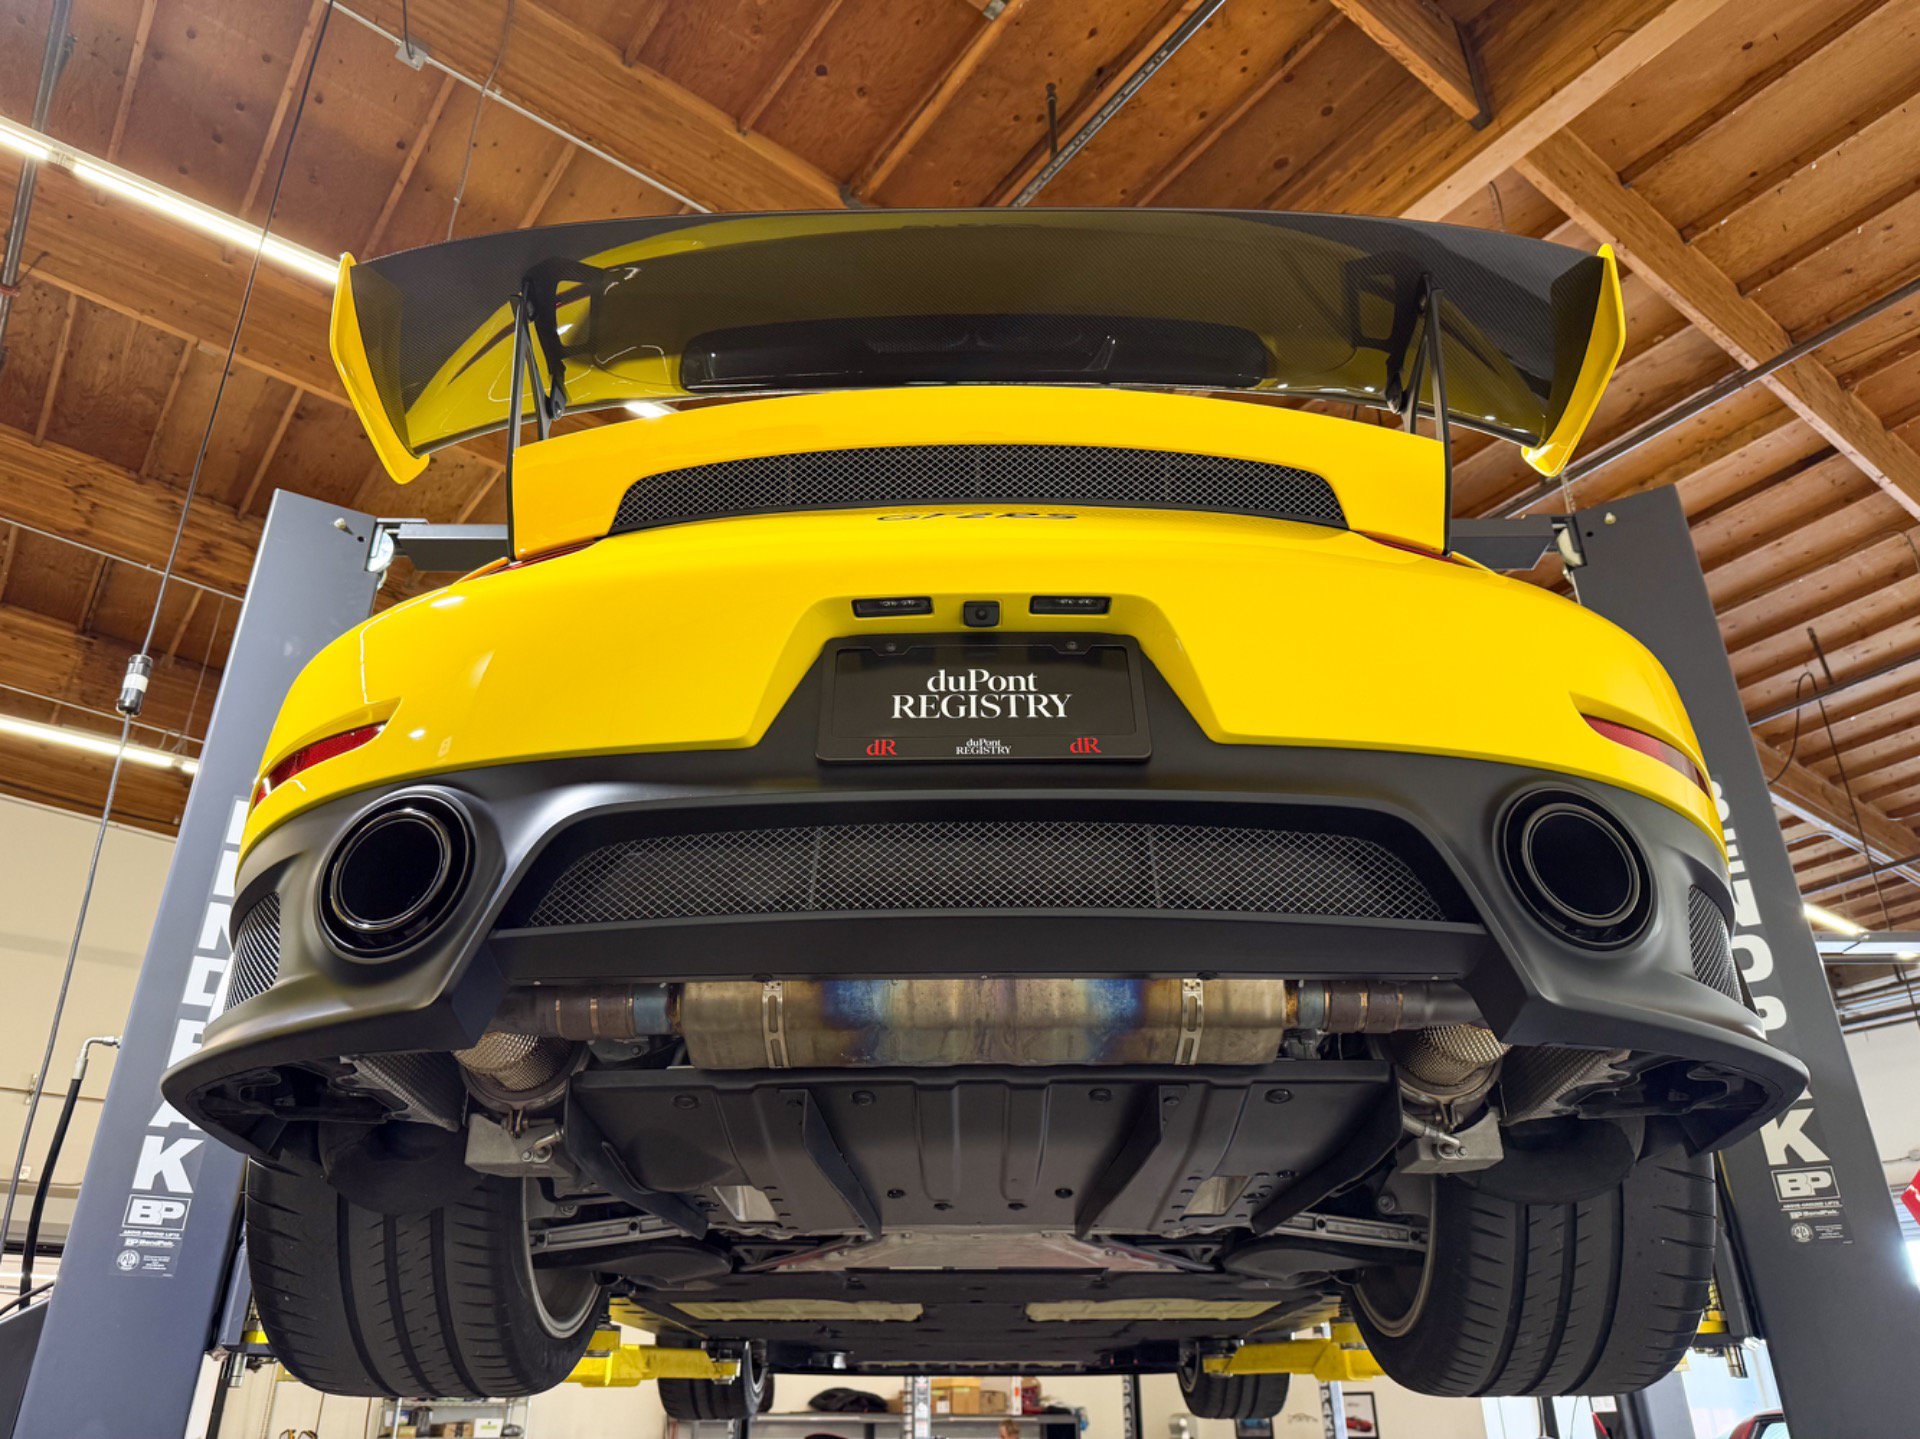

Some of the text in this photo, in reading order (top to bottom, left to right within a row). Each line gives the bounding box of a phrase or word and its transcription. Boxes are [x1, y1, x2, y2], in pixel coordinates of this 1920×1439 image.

[926, 668, 1038, 692] duPont
[891, 693, 1073, 719] REGISTRY
[866, 739, 898, 757] dR
[956, 745, 1012, 755] REGISTRY
[965, 737, 1001, 748] duPont
[1069, 737, 1102, 754] dR
[1776, 1170, 1832, 1198] BP
[127, 1198, 186, 1225] BP
